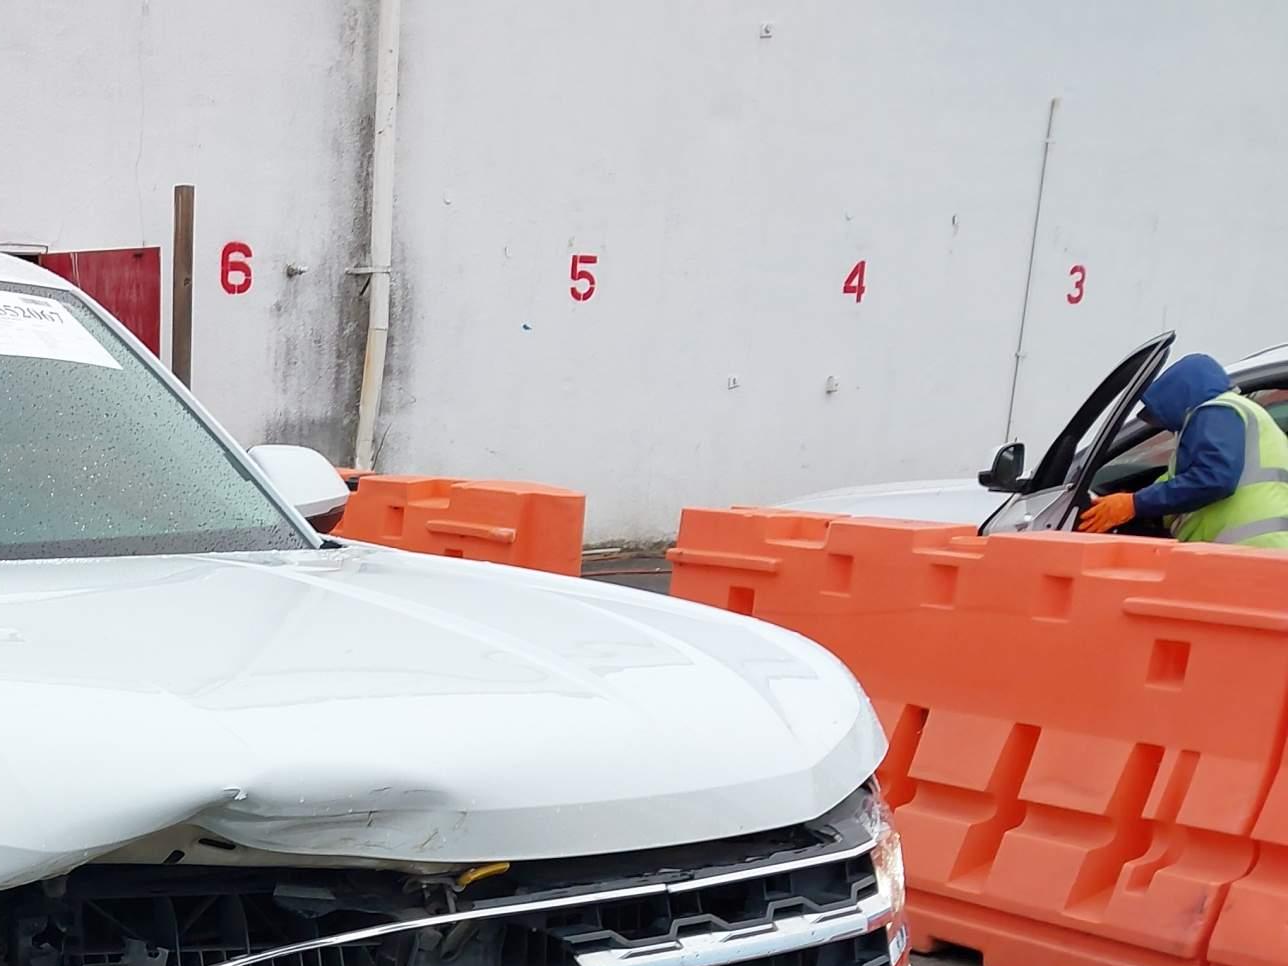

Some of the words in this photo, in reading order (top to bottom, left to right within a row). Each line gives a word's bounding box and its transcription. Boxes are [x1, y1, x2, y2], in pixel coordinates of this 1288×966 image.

[220, 241, 253, 295] 6
[570, 254, 598, 302] 5
[843, 260, 866, 303] 4
[1067, 265, 1086, 305] 3
